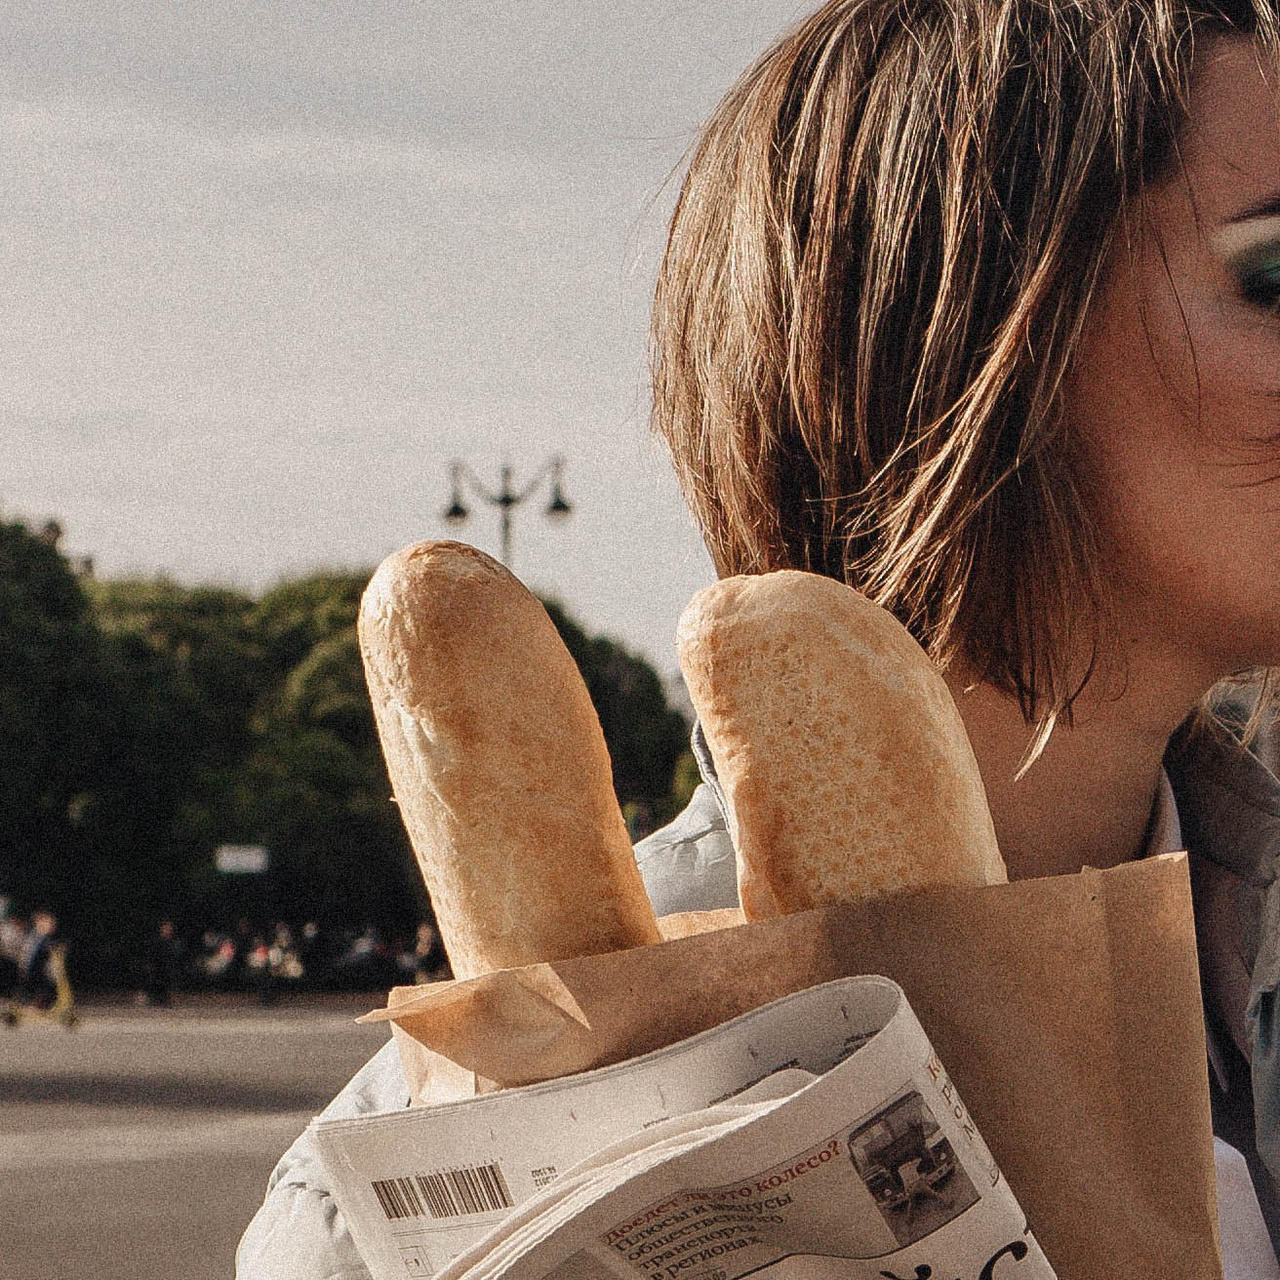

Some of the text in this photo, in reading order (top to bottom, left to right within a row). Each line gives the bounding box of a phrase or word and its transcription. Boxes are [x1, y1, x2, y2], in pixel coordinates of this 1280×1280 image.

[757, 1140, 842, 1195] колесо?
[615, 1209, 690, 1253] Плюсы
[666, 1235, 762, 1280] регионах
